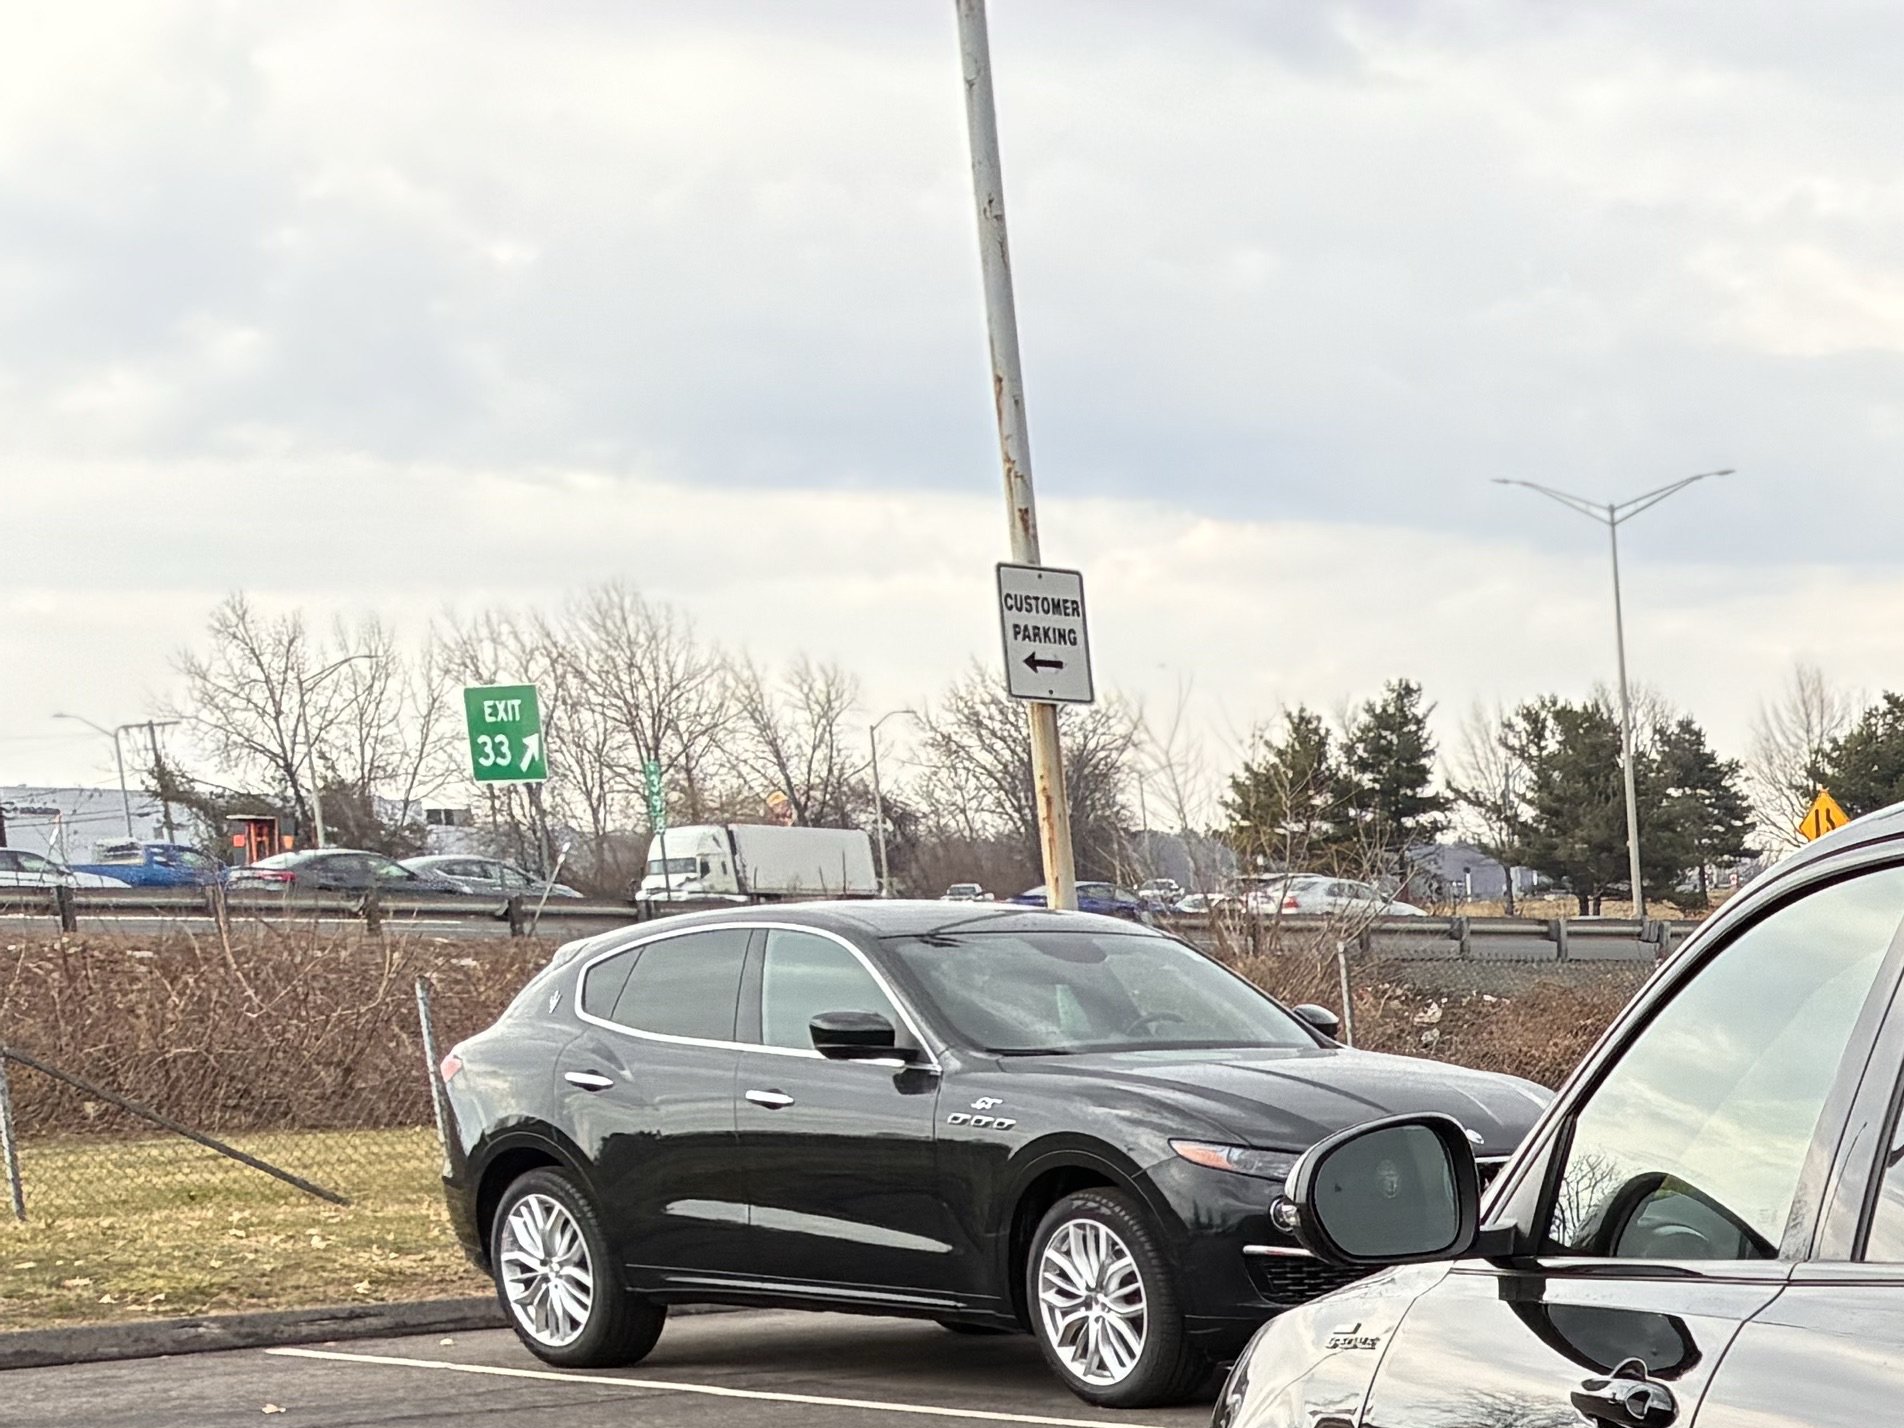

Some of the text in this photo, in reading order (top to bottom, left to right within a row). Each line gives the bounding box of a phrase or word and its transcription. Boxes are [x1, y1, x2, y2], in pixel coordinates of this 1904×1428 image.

[1003, 593, 1081, 618] CUSTOMER
[1012, 623, 1078, 647] PARKING
[483, 699, 521, 723] EXIT
[477, 734, 512, 767] 33
